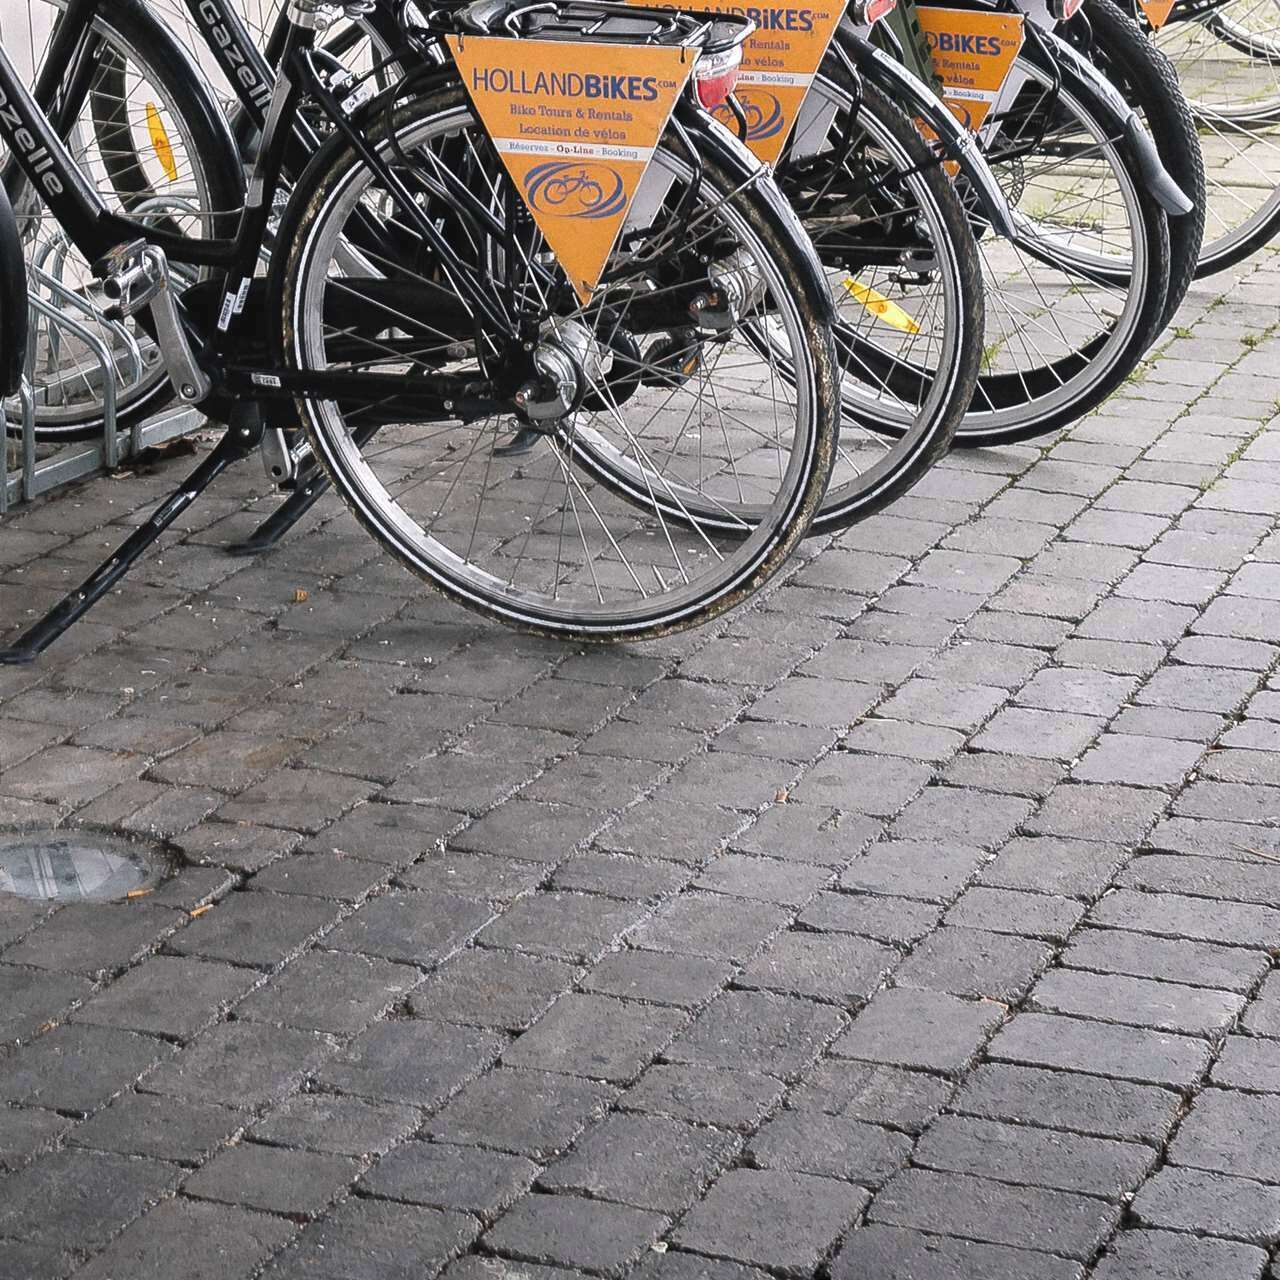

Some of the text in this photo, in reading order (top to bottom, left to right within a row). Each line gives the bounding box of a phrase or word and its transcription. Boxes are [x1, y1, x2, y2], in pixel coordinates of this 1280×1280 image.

[749, 39, 790, 50] Rentals
[199, 0, 273, 121] Gazell
[755, 56, 785, 67] vélos
[510, 103, 633, 121] Bike Tours & Rentals
[519, 123, 626, 140] Location de vélos
[602, 147, 638, 159] Booking
